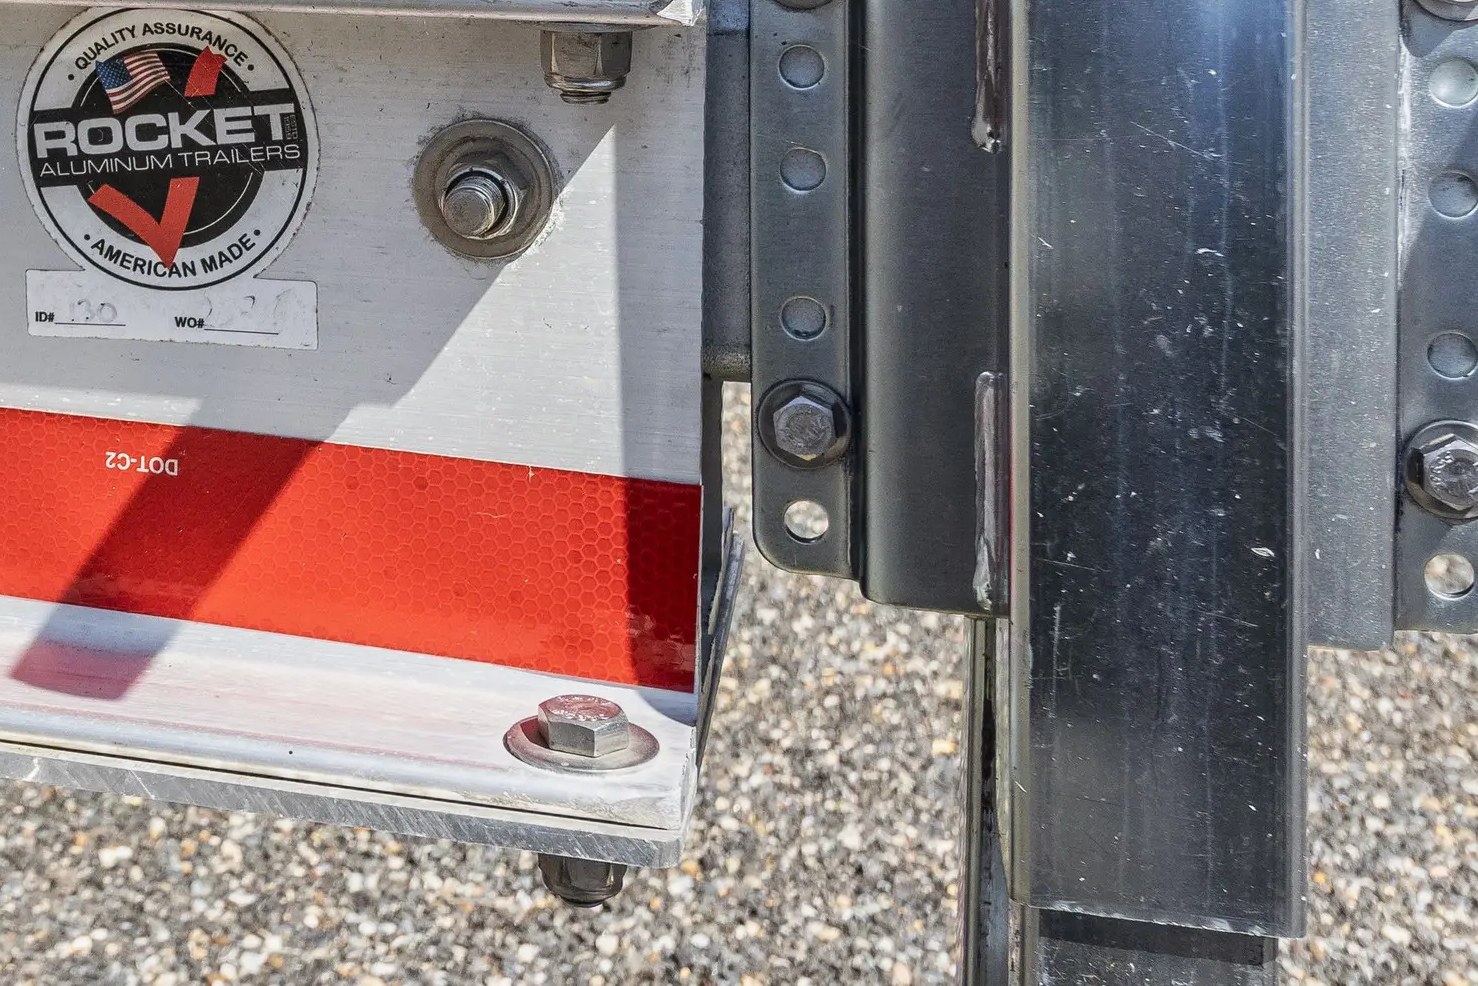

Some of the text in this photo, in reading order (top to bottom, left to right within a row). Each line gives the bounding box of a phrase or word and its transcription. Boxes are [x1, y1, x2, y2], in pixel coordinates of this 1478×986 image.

[74, 22, 249, 70] QUALITY ASSURANCE
[33, 103, 295, 159] ROCKET
[39, 144, 301, 177] ALUMINUM TRAILERS
[90, 232, 256, 279] AMERICAN MADE
[35, 311, 55, 323] ID#
[174, 316, 205, 330] WO#
[105, 451, 179, 476] DOT-C2
